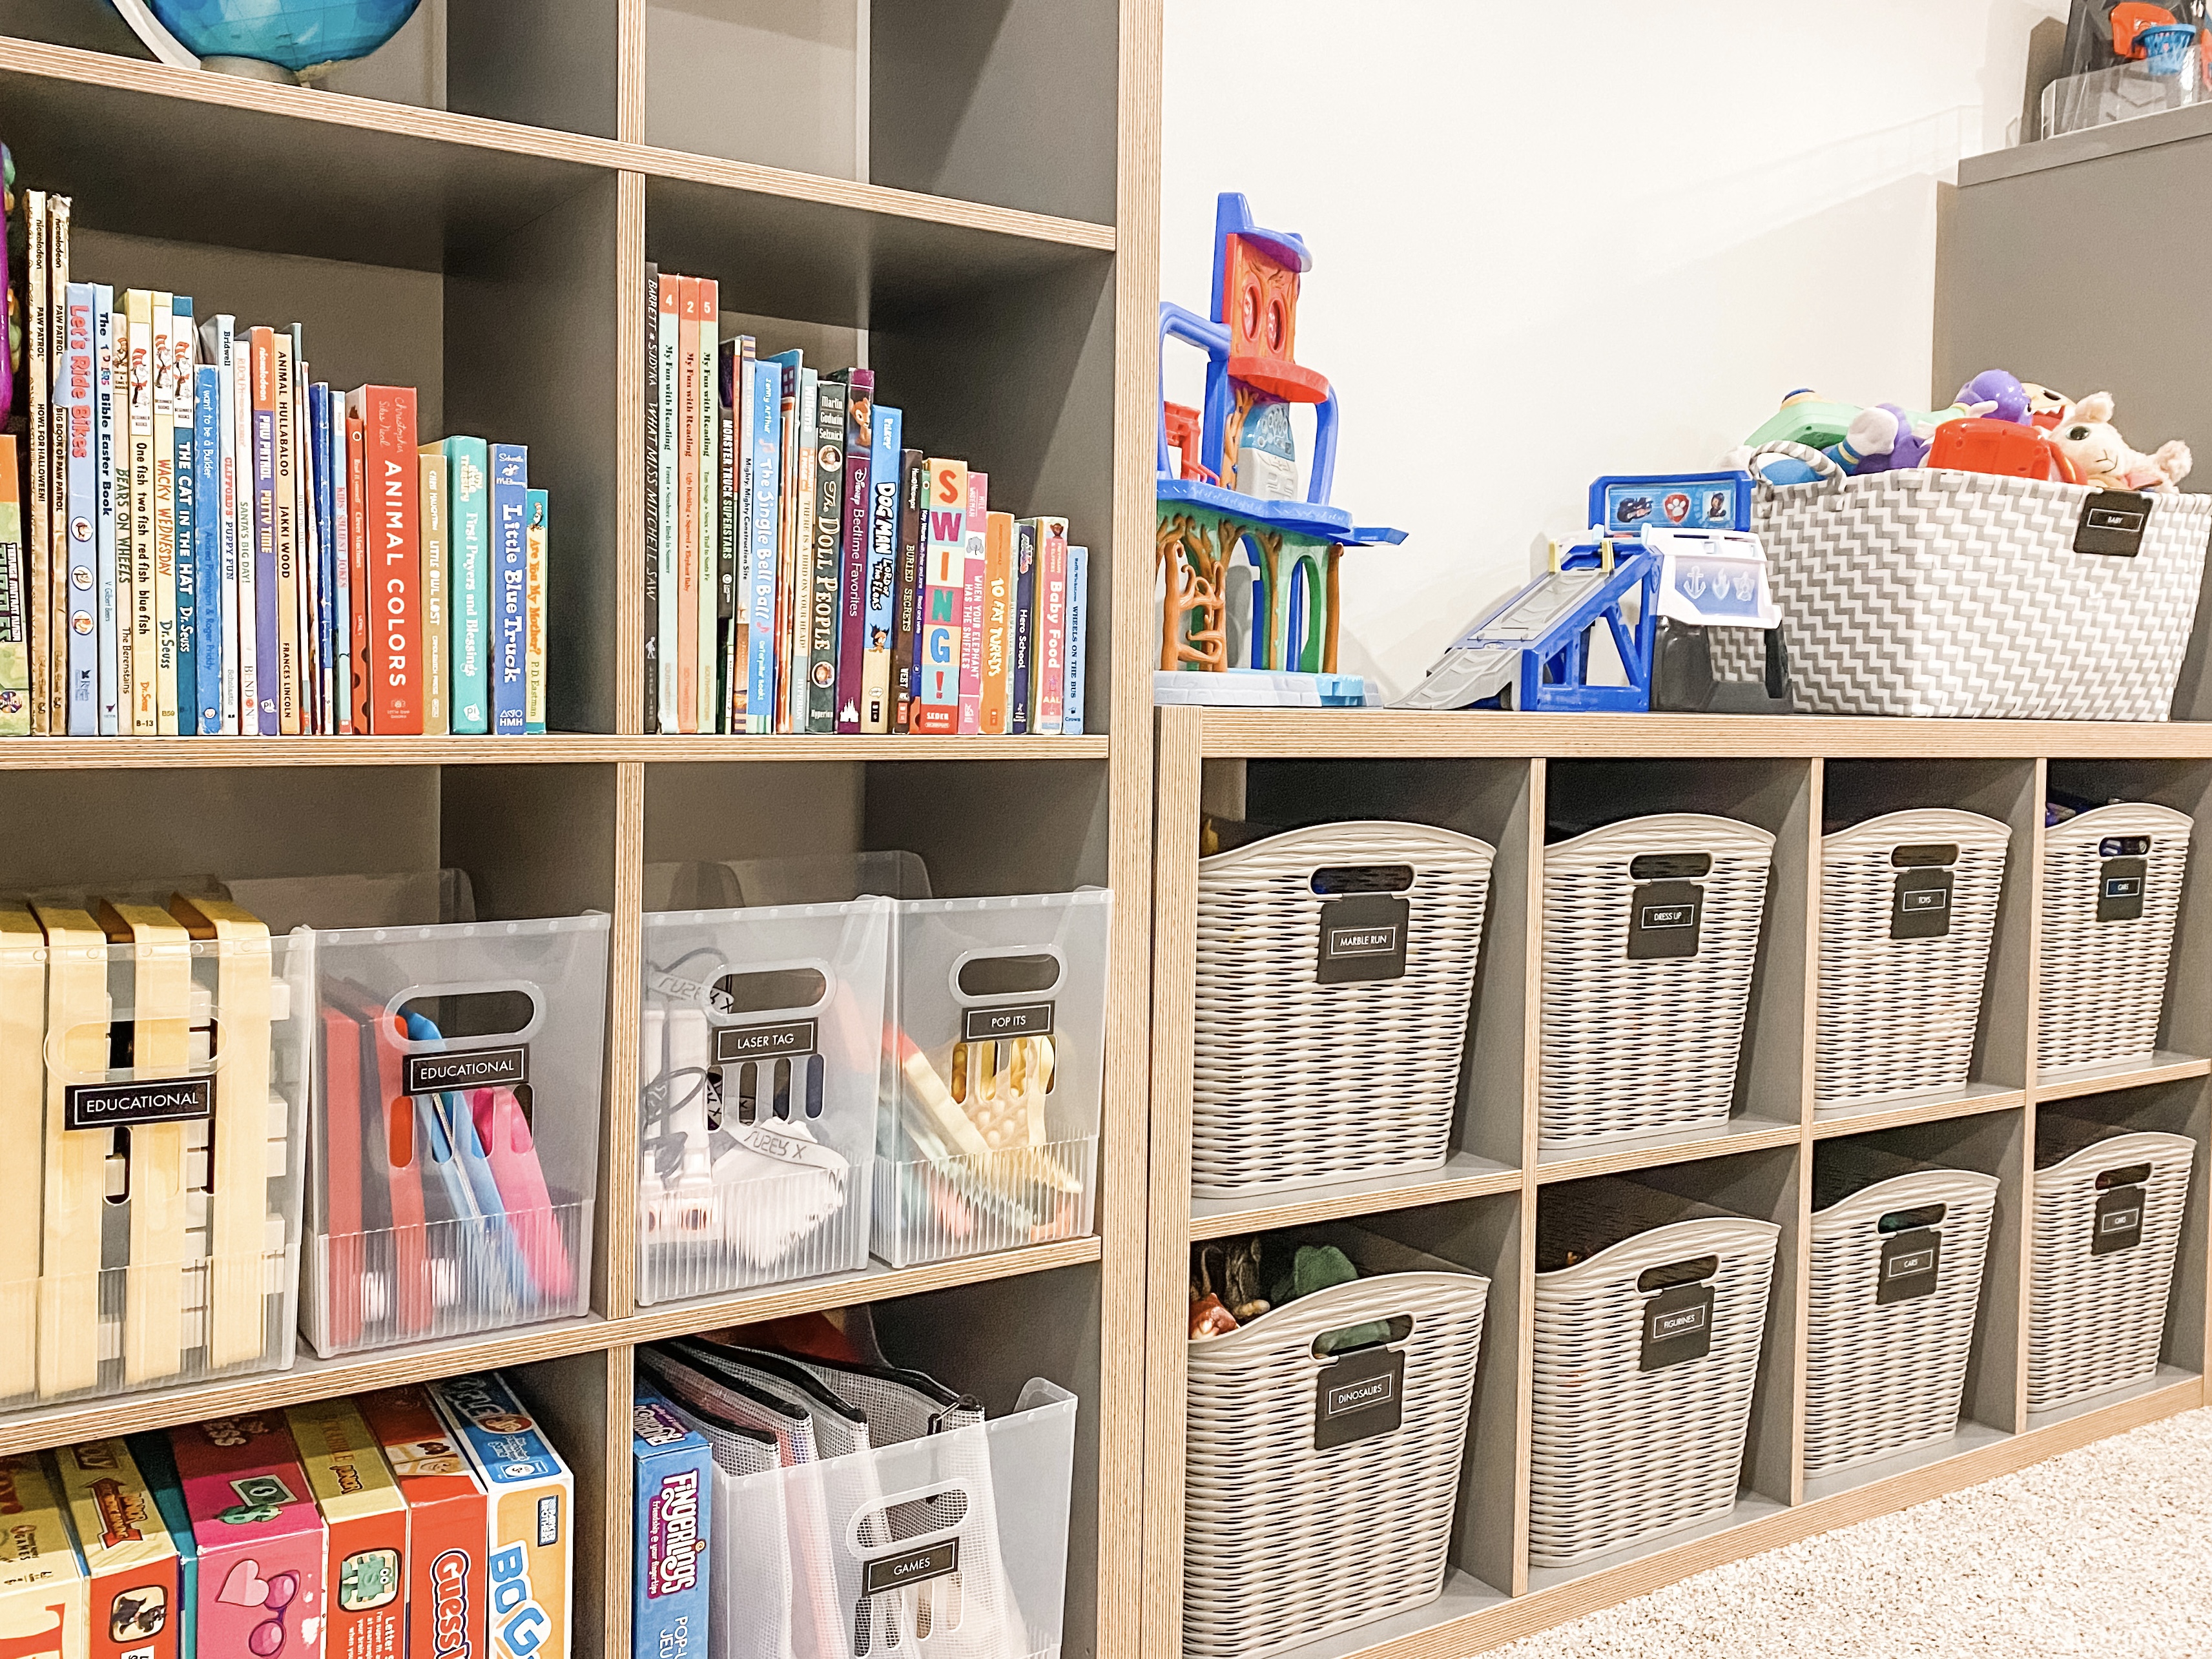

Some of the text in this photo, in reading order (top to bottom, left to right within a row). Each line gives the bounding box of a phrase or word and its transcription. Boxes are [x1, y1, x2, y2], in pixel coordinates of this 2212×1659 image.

[665, 294, 672, 306] 4
[687, 302, 694, 313] 2
[704, 302, 710, 314] 5
[70, 305, 91, 458] Let's Ride Bikes
[763, 377, 772, 403] Jenny
[804, 386, 815, 433] Willems
[820, 411, 843, 426] Godwin
[822, 395, 843, 410] Martin
[56, 446, 63, 459] OF
[819, 428, 843, 442] Selznick
[278, 351, 290, 579] ANIMAL HULLABALOO JAKKI WOOD
[760, 458, 771, 487] The
[722, 420, 733, 559] MONSTER TRUCK SUPERSTARS
[116, 468, 130, 583] BEARS ON WHEELS
[158, 459, 172, 577] WACKY WEDNESDAY
[240, 501, 249, 540] SANTA'S
[385, 460, 404, 566] ANIMAL
[755, 490, 774, 544] Jingle
[874, 482, 896, 555] DOG MAN
[136, 443, 150, 635] One fish two fish red fish blue fish
[178, 442, 193, 653] THE CAT IN THE HAT Dr. Seuss
[502, 504, 523, 563] Little
[530, 537, 539, 559] Are
[816, 516, 840, 570] DOLL
[849, 467, 867, 617] Disney Bedtime Favorites
[242, 562, 251, 584] DAY!
[529, 562, 539, 581] You
[757, 549, 772, 581] Bell
[460, 512, 479, 677] First Prayers and Blessings
[504, 569, 523, 614] Blue
[527, 584, 540, 604] My
[755, 584, 772, 619] Ball
[965, 583, 973, 603] HAS
[990, 578, 1005, 597] 10
[814, 575, 838, 650] PEOPLE
[900, 544, 915, 688] BURIED SECRETS WEST
[971, 575, 983, 679] WHEN YOUR ELEPHANT
[992, 599, 1006, 624] FAT
[1048, 581, 1062, 669] Baby Food
[160, 620, 175, 670] Dr. Seuss
[387, 579, 406, 687] COLORS
[530, 607, 541, 655] Mother?
[962, 625, 971, 669] SNIFFLES
[1018, 609, 1028, 669] Hero School
[122, 627, 131, 694] The Berenstains
[504, 616, 523, 683] Truck
[988, 627, 1002, 677] TURKEYS
[530, 679, 539, 717] Eastman
[926, 712, 949, 721] SEDER
[1653, 911, 1682, 923] DRESS UP
[1339, 934, 1387, 947] MARBLE RUN
[991, 1015, 1026, 1028] POP ITS
[736, 1033, 794, 1049] LASER TAG
[419, 1058, 515, 1081] EDUCATIONAL
[85, 1090, 200, 1113] EDUCATIONAL
[1664, 1314, 1695, 1330] FIGURINES
[1338, 1383, 1383, 1404] DINOSAURS
[328, 1464, 363, 1494] JUNIOR
[123, 1492, 149, 1523] JUNIOR
[541, 1499, 550, 1544] BROTHERS
[650, 1500, 661, 1534] friendship
[649, 1544, 658, 1560] your
[893, 1556, 931, 1576] GAMES
[648, 1560, 660, 1595] fingertips
[434, 1551, 467, 1650] Guess
[385, 1616, 395, 1651] Letter
